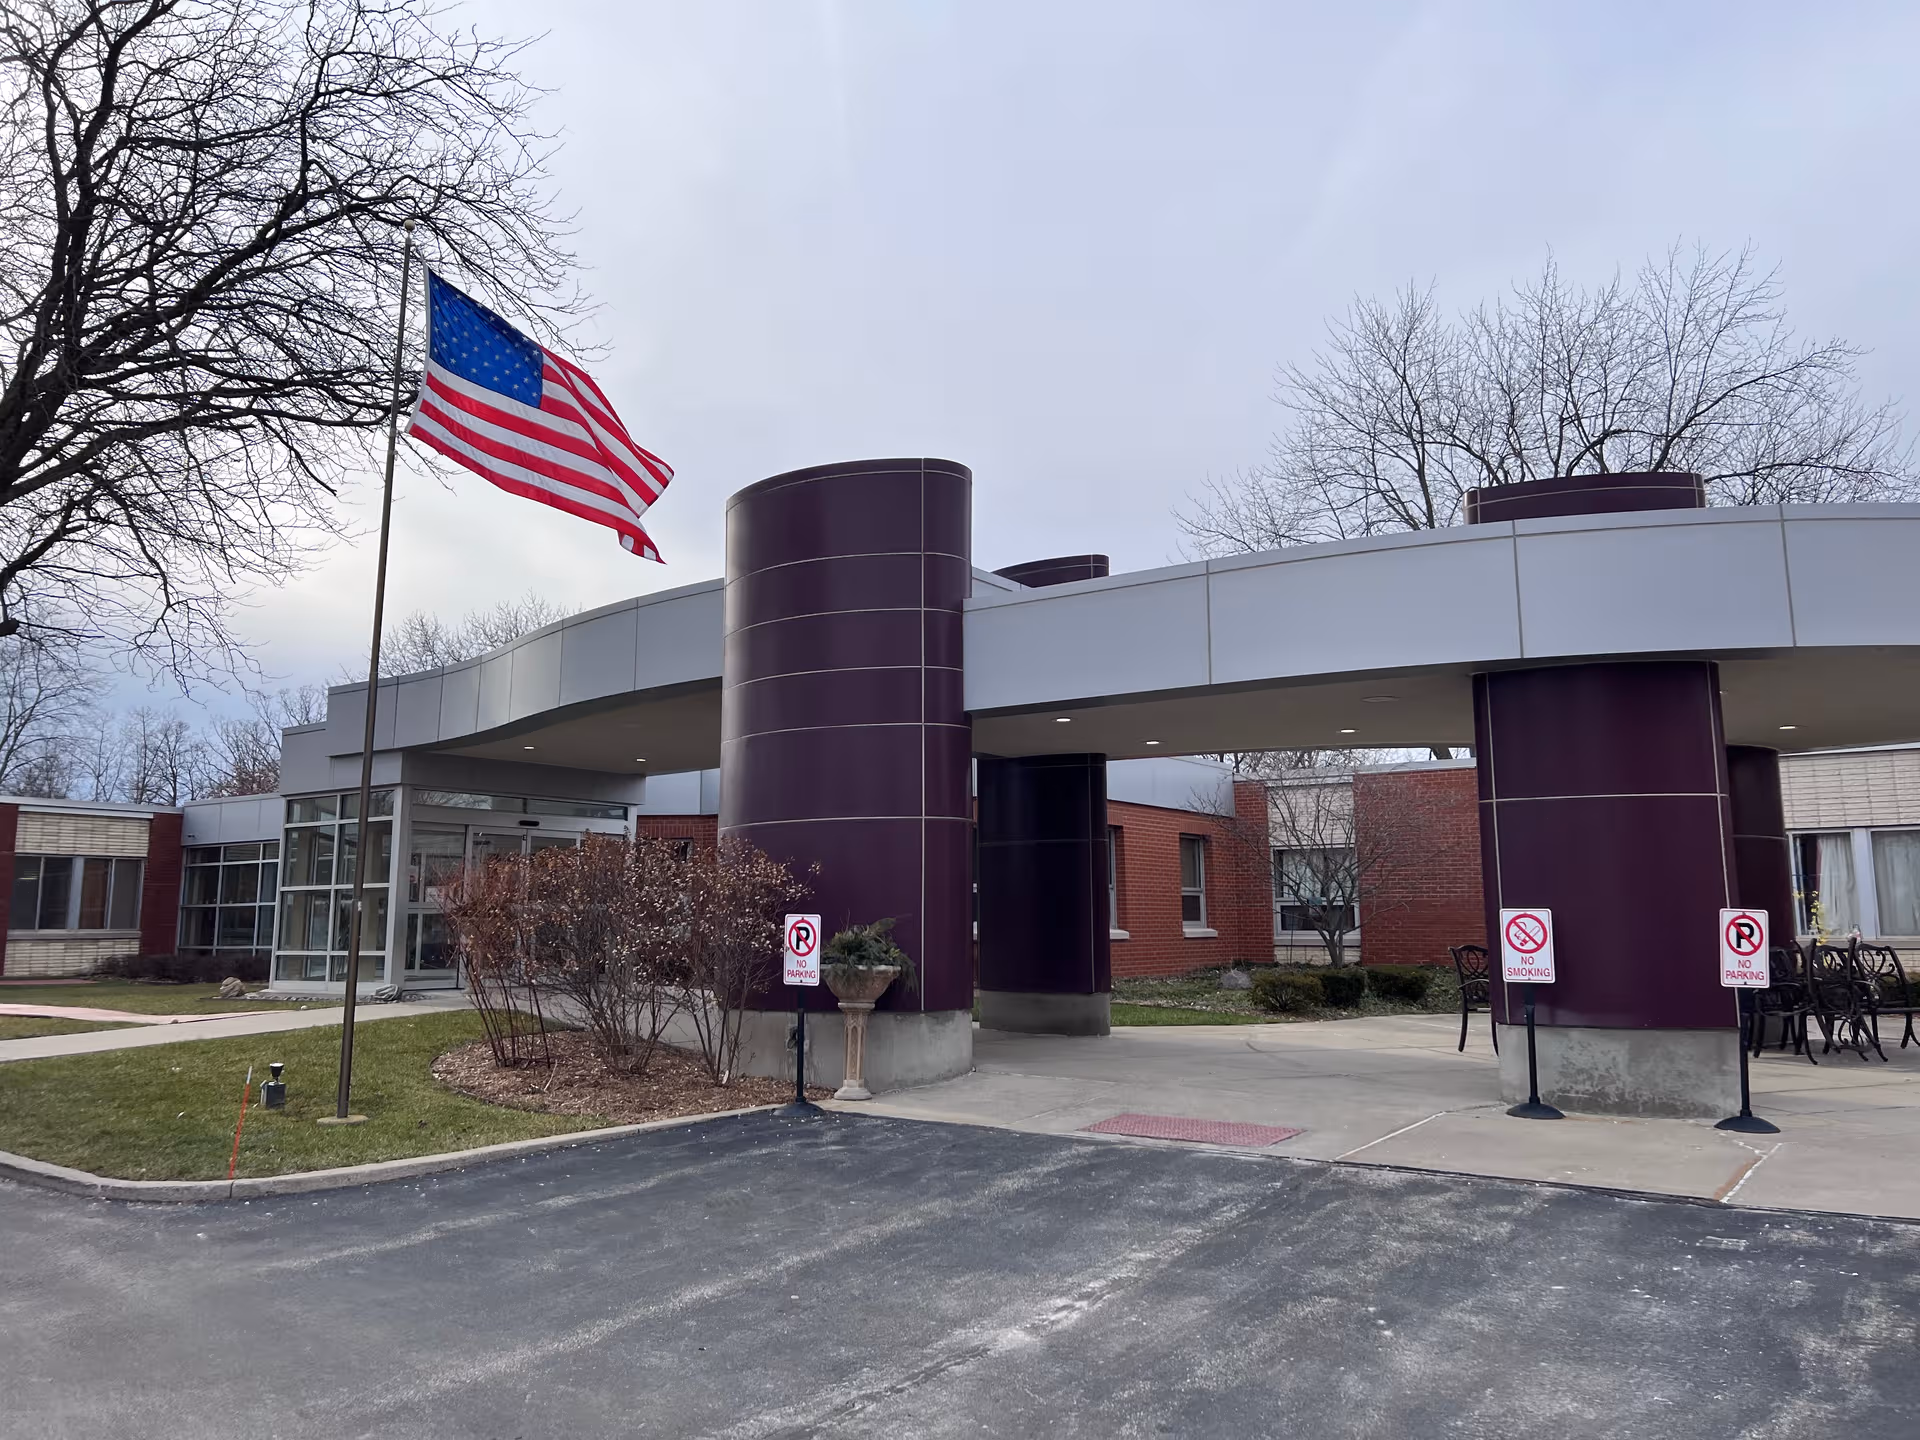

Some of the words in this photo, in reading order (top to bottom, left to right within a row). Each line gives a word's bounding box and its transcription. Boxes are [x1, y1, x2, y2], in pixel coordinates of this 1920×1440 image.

[796, 960, 807, 968] NO
[1521, 956, 1535, 965] NO
[1738, 960, 1751, 969] NO
[787, 969, 816, 979] PARKING
[1507, 967, 1551, 977] SMOKING
[1726, 970, 1764, 981] PARKING
